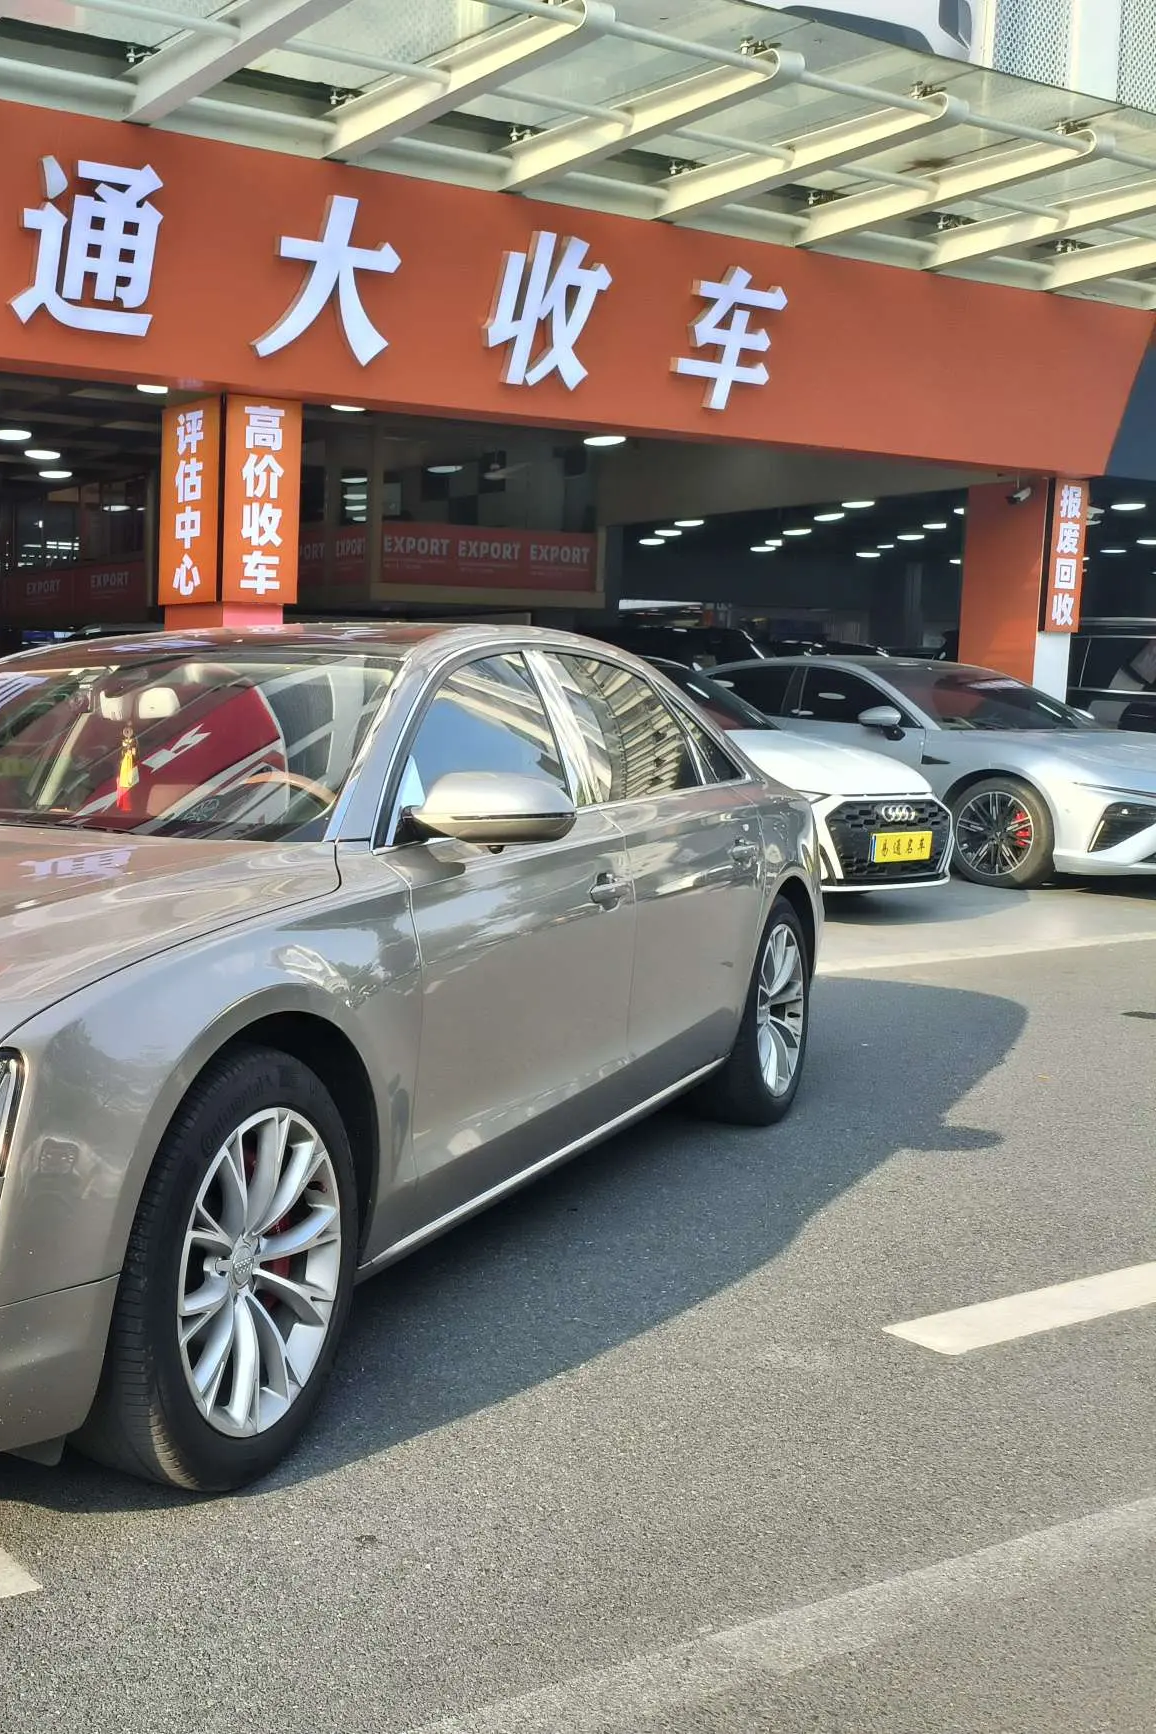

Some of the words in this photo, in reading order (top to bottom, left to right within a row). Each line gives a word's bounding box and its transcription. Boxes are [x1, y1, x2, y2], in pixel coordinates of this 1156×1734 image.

[173, 409, 204, 597] 评估中心
[239, 405, 286, 596] 高价收车
[383, 535, 450, 556] EXPORT
[458, 539, 521, 561] EXPORT
[530, 543, 590, 564] EXPORT
[1052, 485, 1082, 627] 报废回收
[26, 579, 61, 596] EXPORT
[90, 571, 129, 589] EXPORT
[881, 838, 925, 857] 易通名车
